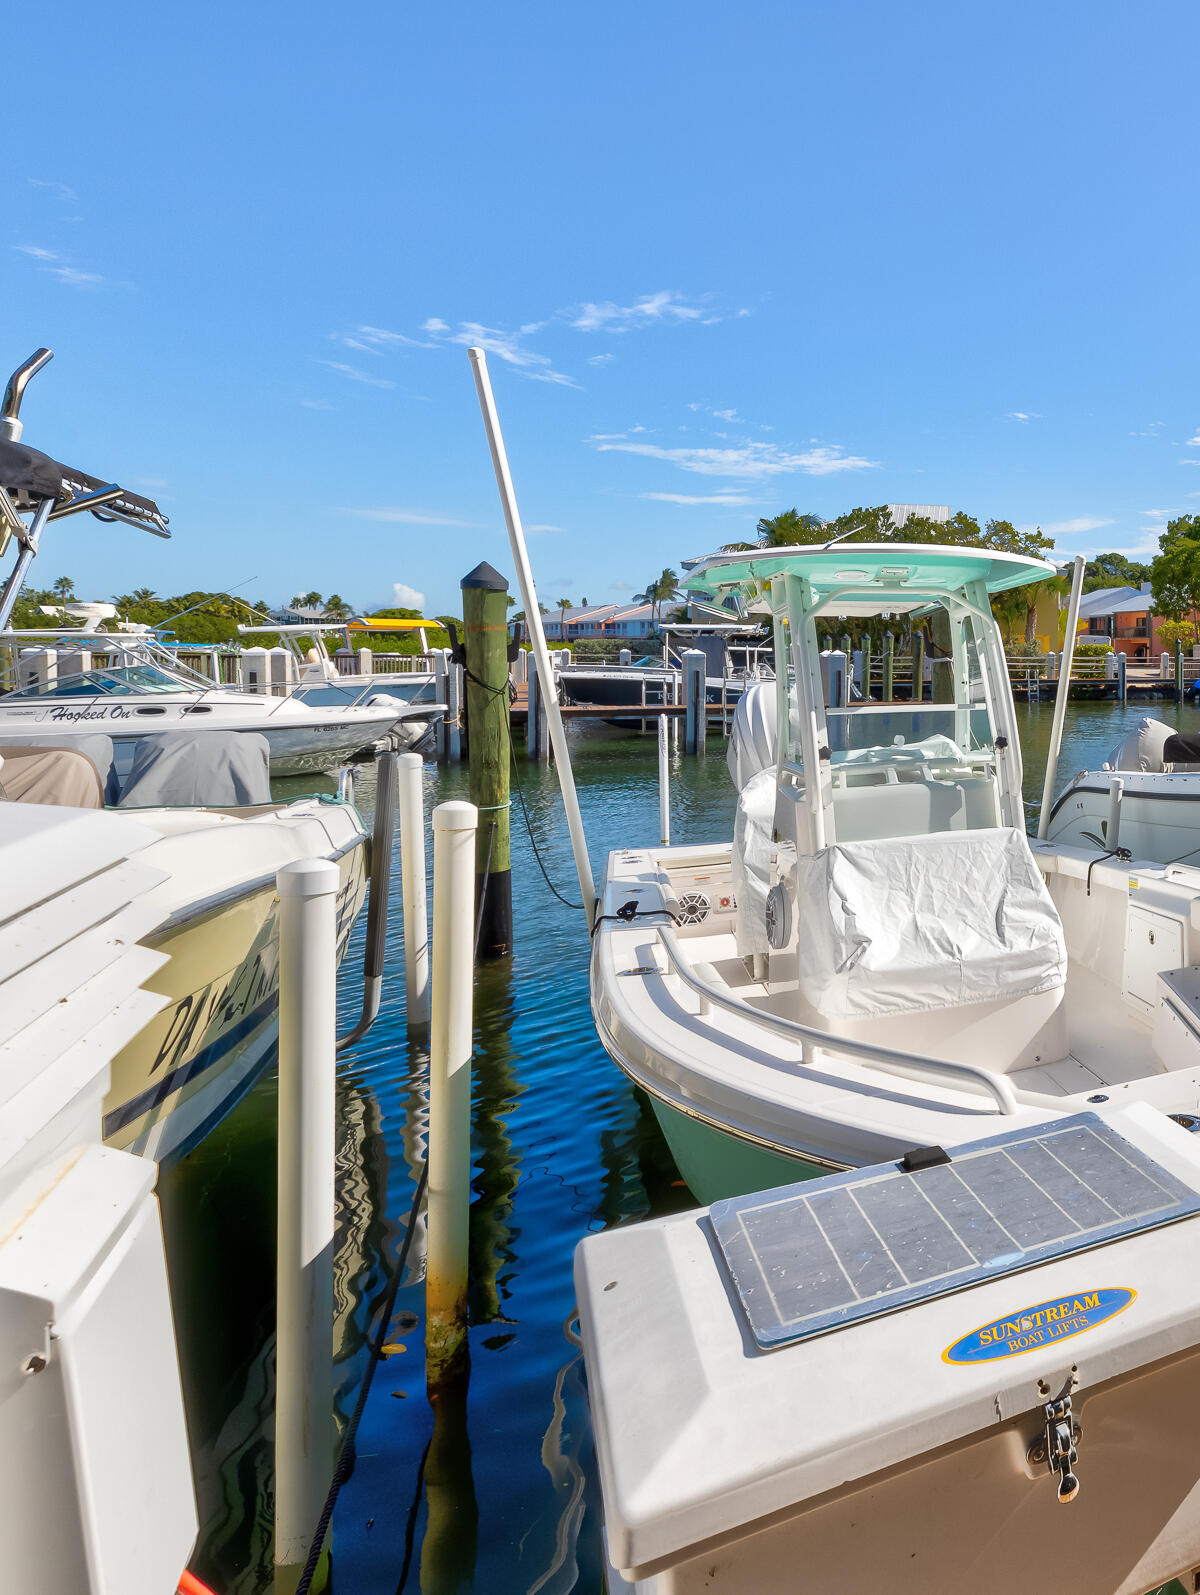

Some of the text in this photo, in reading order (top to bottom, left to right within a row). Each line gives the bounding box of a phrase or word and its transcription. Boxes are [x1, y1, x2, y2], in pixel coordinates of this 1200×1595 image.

[50, 705, 130, 723] Hooked On
[979, 1292, 1102, 1346] SUNSTREAM
[1007, 1315, 1090, 1353] BOAT LIFTS
